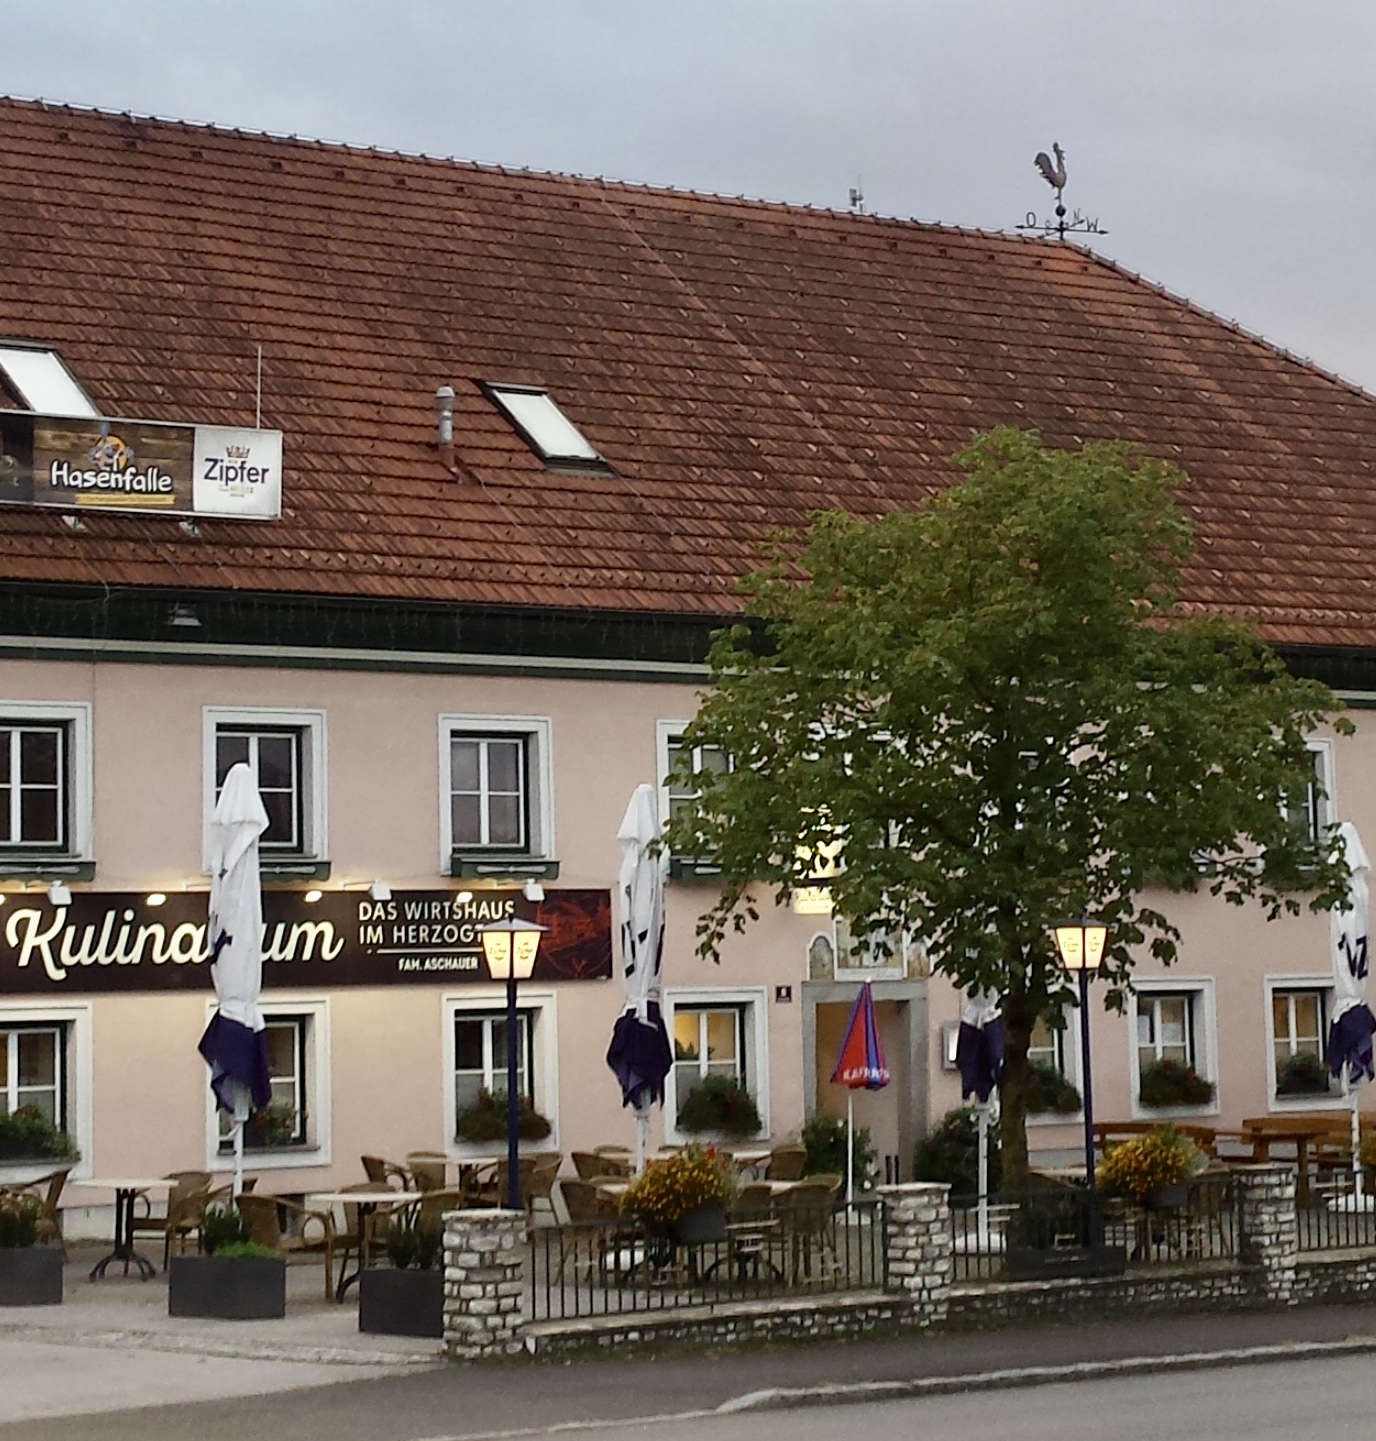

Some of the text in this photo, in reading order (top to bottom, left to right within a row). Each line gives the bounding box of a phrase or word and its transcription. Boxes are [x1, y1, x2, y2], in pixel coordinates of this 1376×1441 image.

[50, 459, 173, 492] Hasenfalle
[204, 457, 270, 487] Zipfer
[359, 900, 515, 921] DAS WIRTSHAUS
[5, 905, 345, 981] Kulinaum
[359, 924, 485, 945] IM HERZOGT
[424, 956, 479, 972] ASCHAUER
